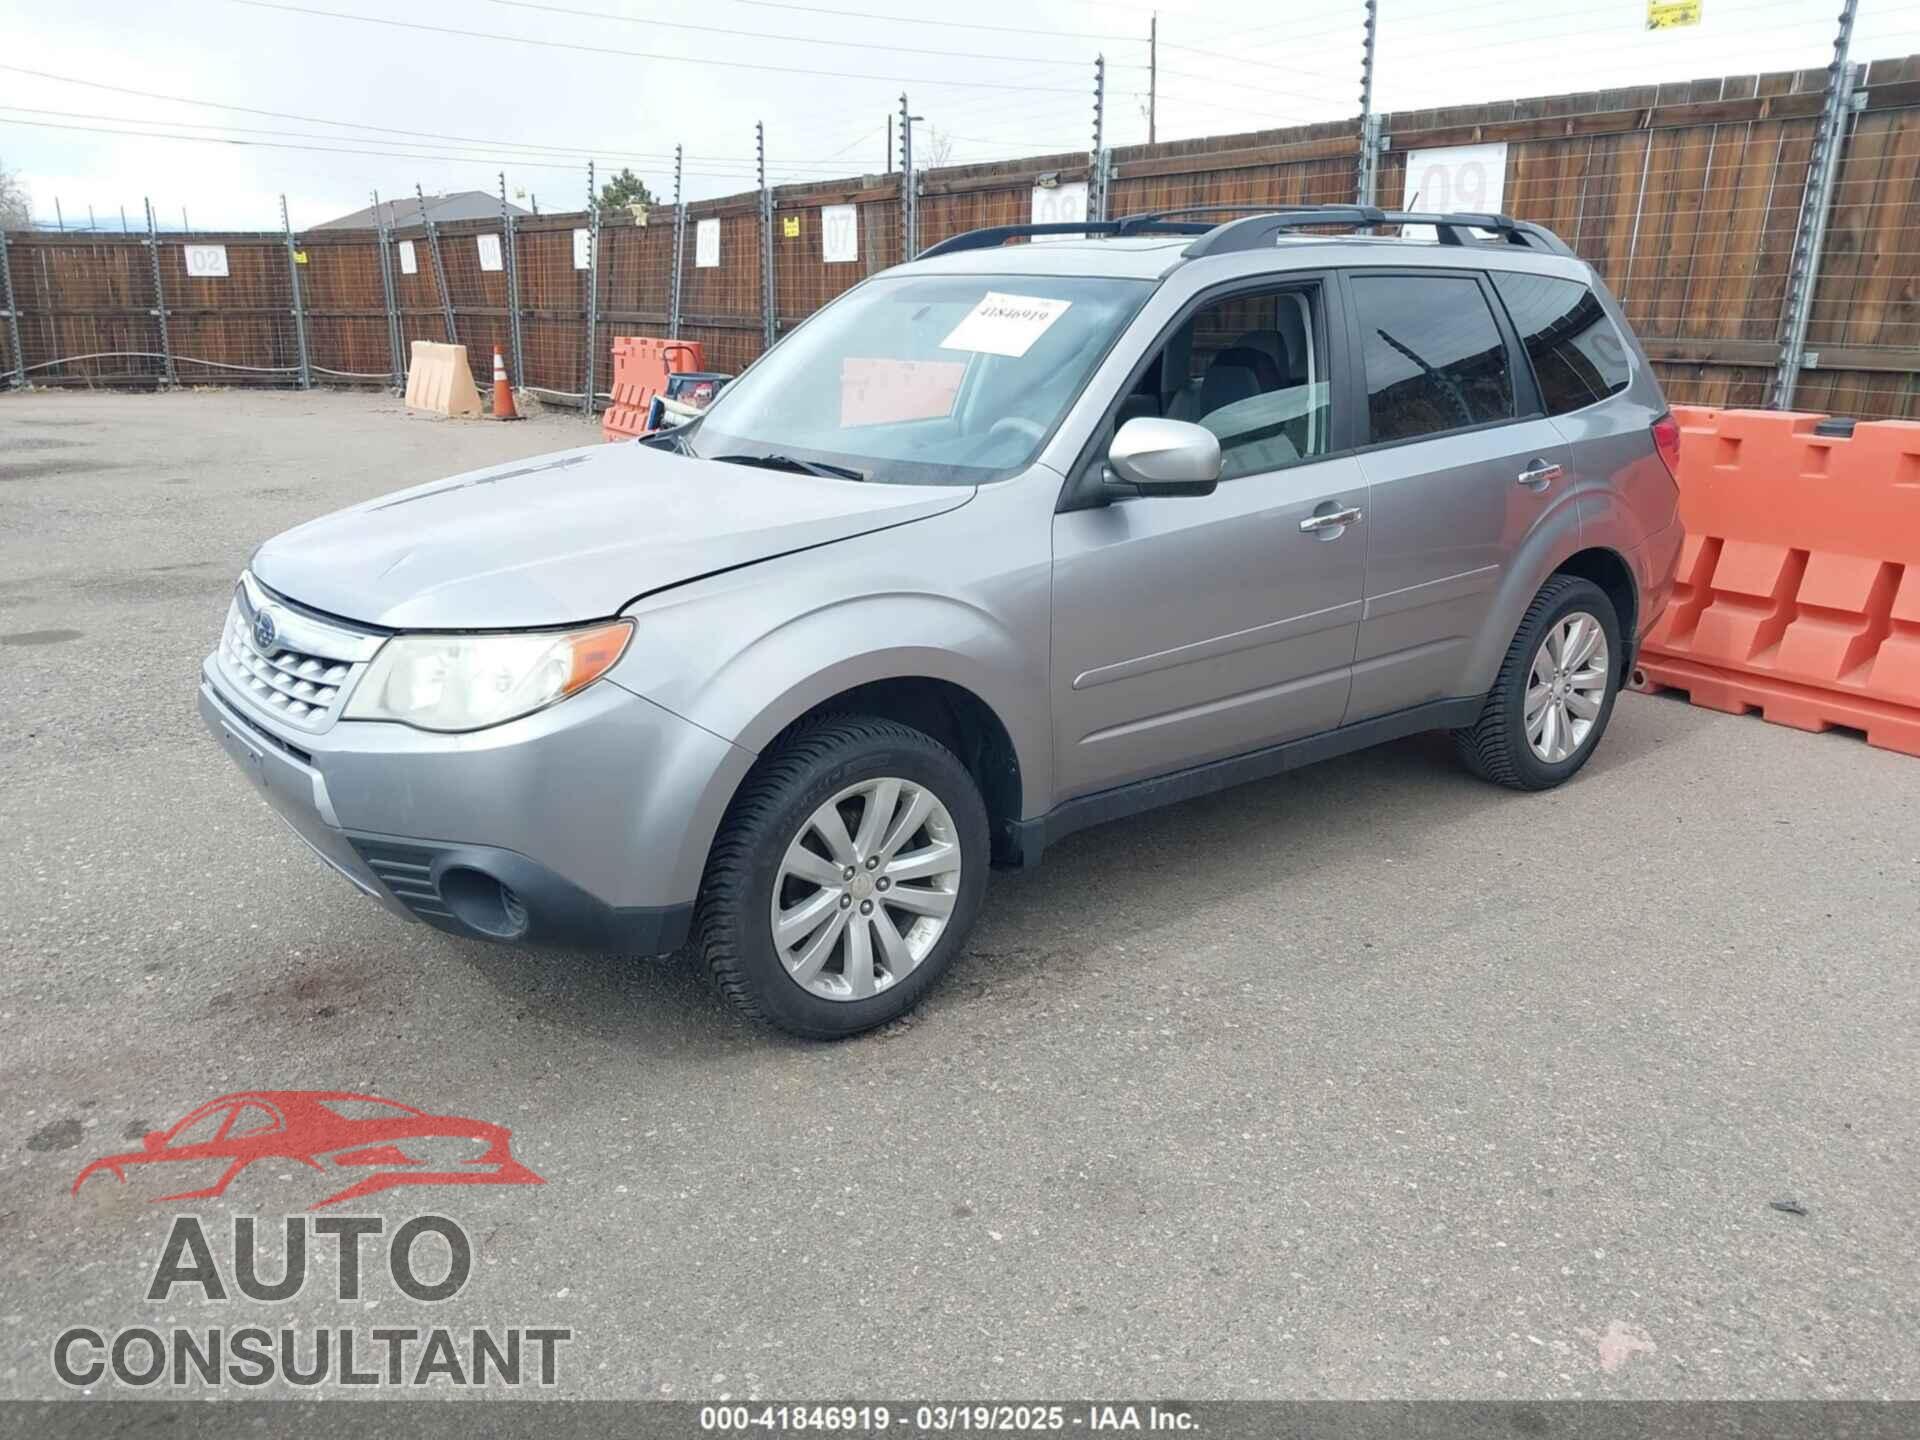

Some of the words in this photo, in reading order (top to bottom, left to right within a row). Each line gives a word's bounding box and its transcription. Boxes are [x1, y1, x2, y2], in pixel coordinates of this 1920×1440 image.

[1418, 162, 1484, 213] 09
[193, 250, 221, 272] 02
[979, 306, 1049, 321] 41846919
